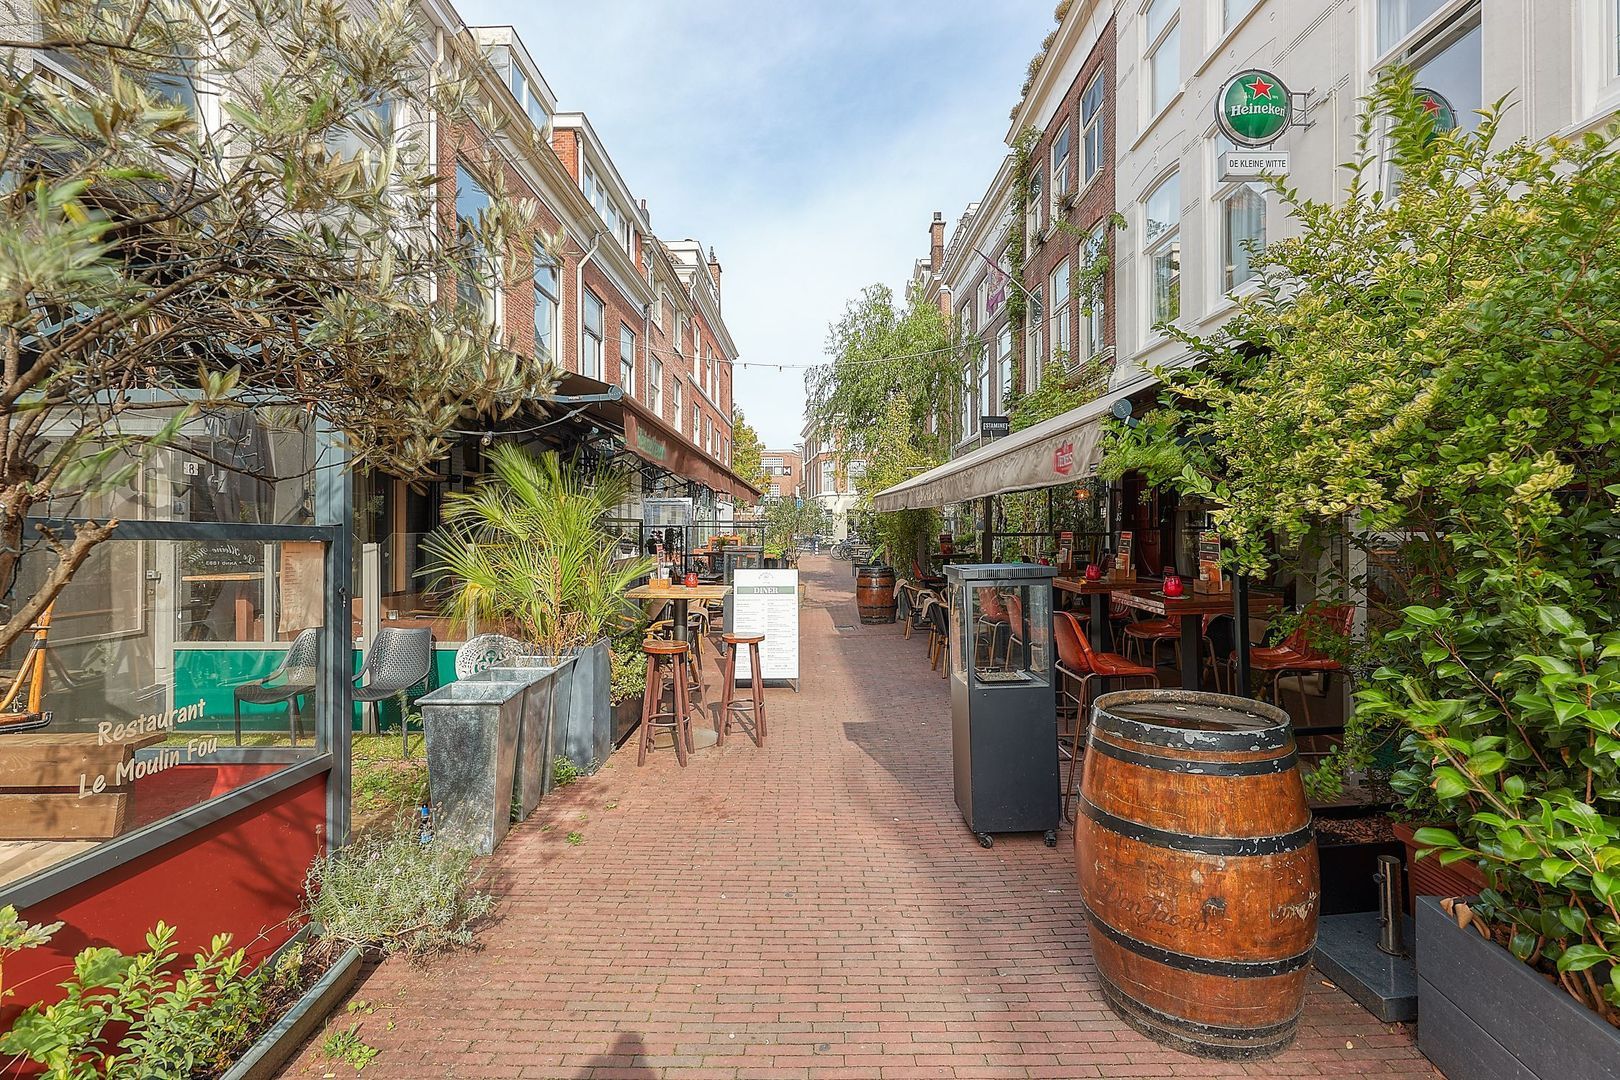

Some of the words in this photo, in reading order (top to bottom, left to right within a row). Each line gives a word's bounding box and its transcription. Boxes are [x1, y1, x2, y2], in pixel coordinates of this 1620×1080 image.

[1230, 103, 1285, 117] Heineken
[1229, 159, 1239, 168] DE
[1240, 159, 1264, 168] KLEINE
[1265, 159, 1286, 168] WITTE
[188, 463, 195, 475] 8
[753, 586, 779, 594] DINER
[98, 698, 206, 746] Restaurant
[79, 773, 107, 800] Le
[115, 748, 180, 786] Moulin
[187, 737, 218, 761] Fou
